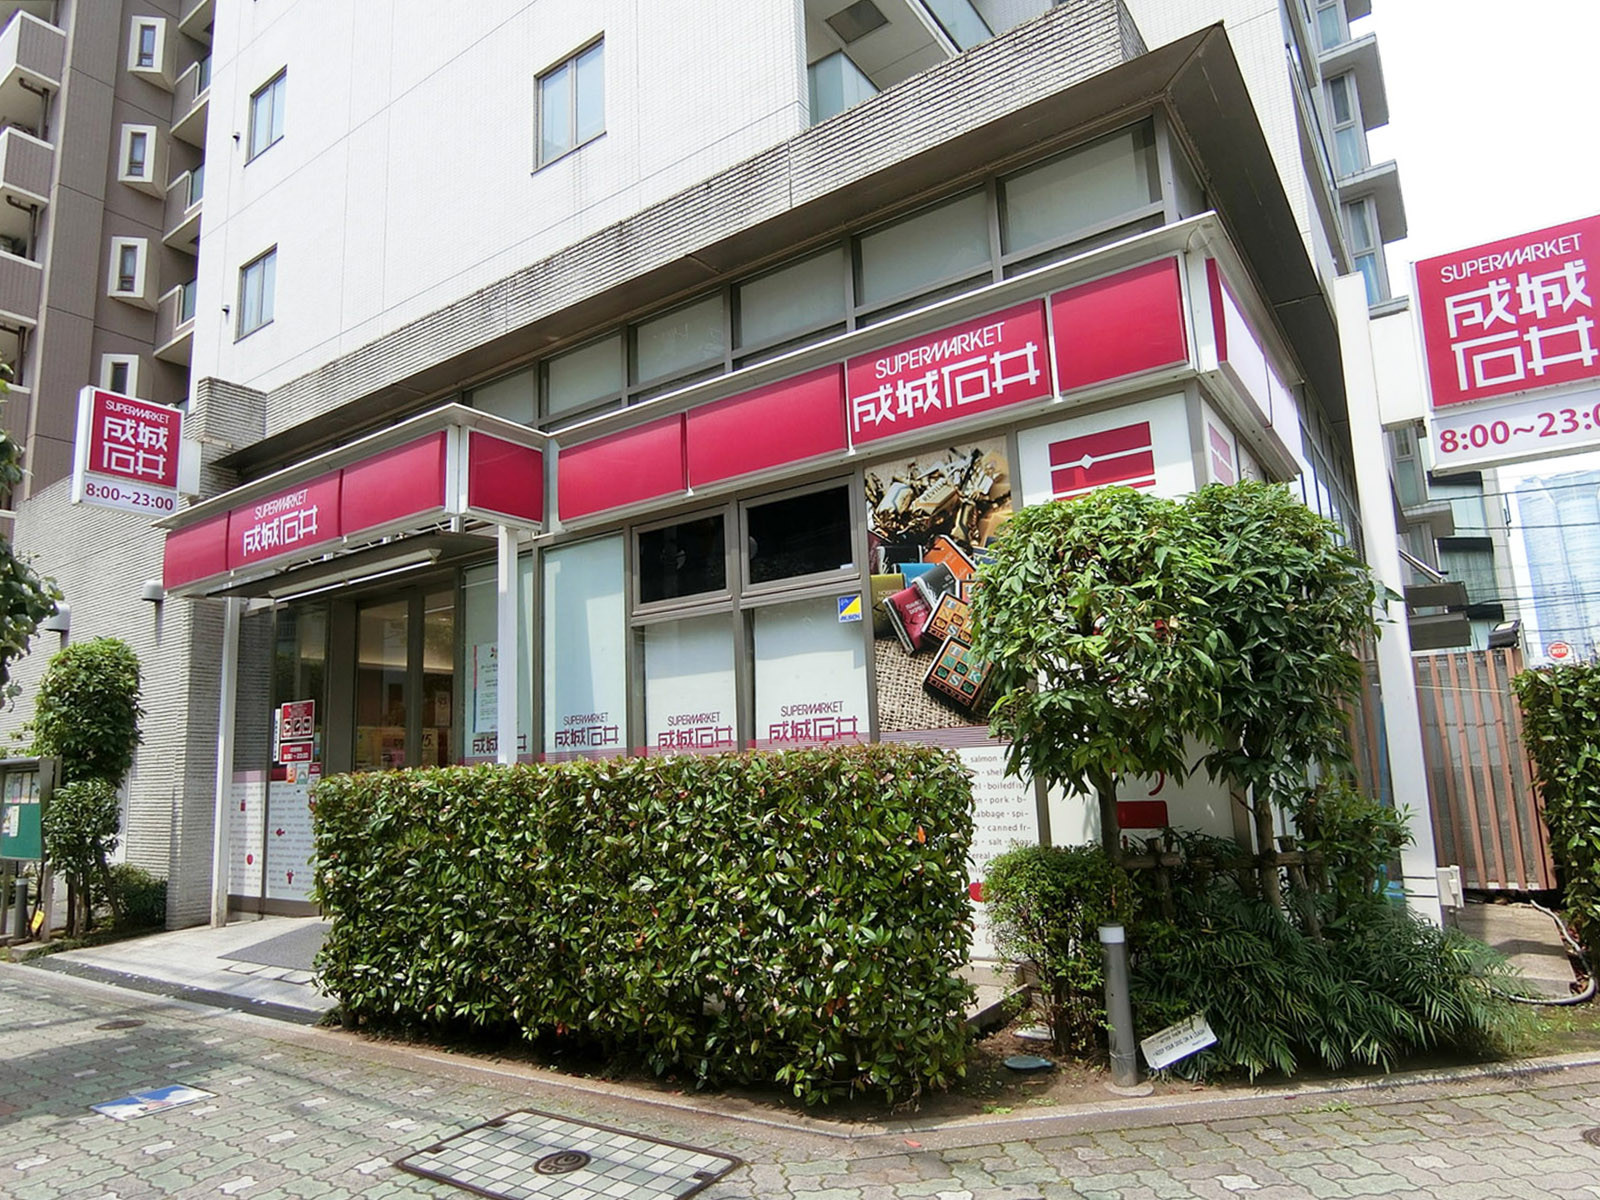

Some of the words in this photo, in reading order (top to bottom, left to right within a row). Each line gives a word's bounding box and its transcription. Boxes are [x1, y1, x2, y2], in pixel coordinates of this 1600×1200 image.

[1441, 232, 1582, 284] SUPERMARKET
[1445, 259, 1593, 339] 成城
[875, 321, 1005, 379] SUPERMARKET
[1451, 316, 1600, 391] 石井
[853, 341, 1041, 432] 成城石井
[105, 400, 170, 424] SUPERMARKET
[104, 416, 169, 452] 成城
[103, 441, 167, 479] 石井
[86, 483, 174, 511] 8:00~23:00
[254, 488, 309, 520] SUPERMARKET
[243, 504, 319, 556] 成城石井
[563, 712, 609, 725] SUPERMARKET
[667, 712, 721, 727] SUPERMARKET
[781, 700, 844, 717] SUPERMARKET
[555, 724, 619, 748] 成城石井
[658, 725, 733, 751] 成城石井
[769, 715, 858, 744] 成城石井
[970, 755, 997, 763] salmon
[990, 796, 1008, 804] pork
[987, 824, 1018, 832] canned
[989, 838, 1002, 846] salt
